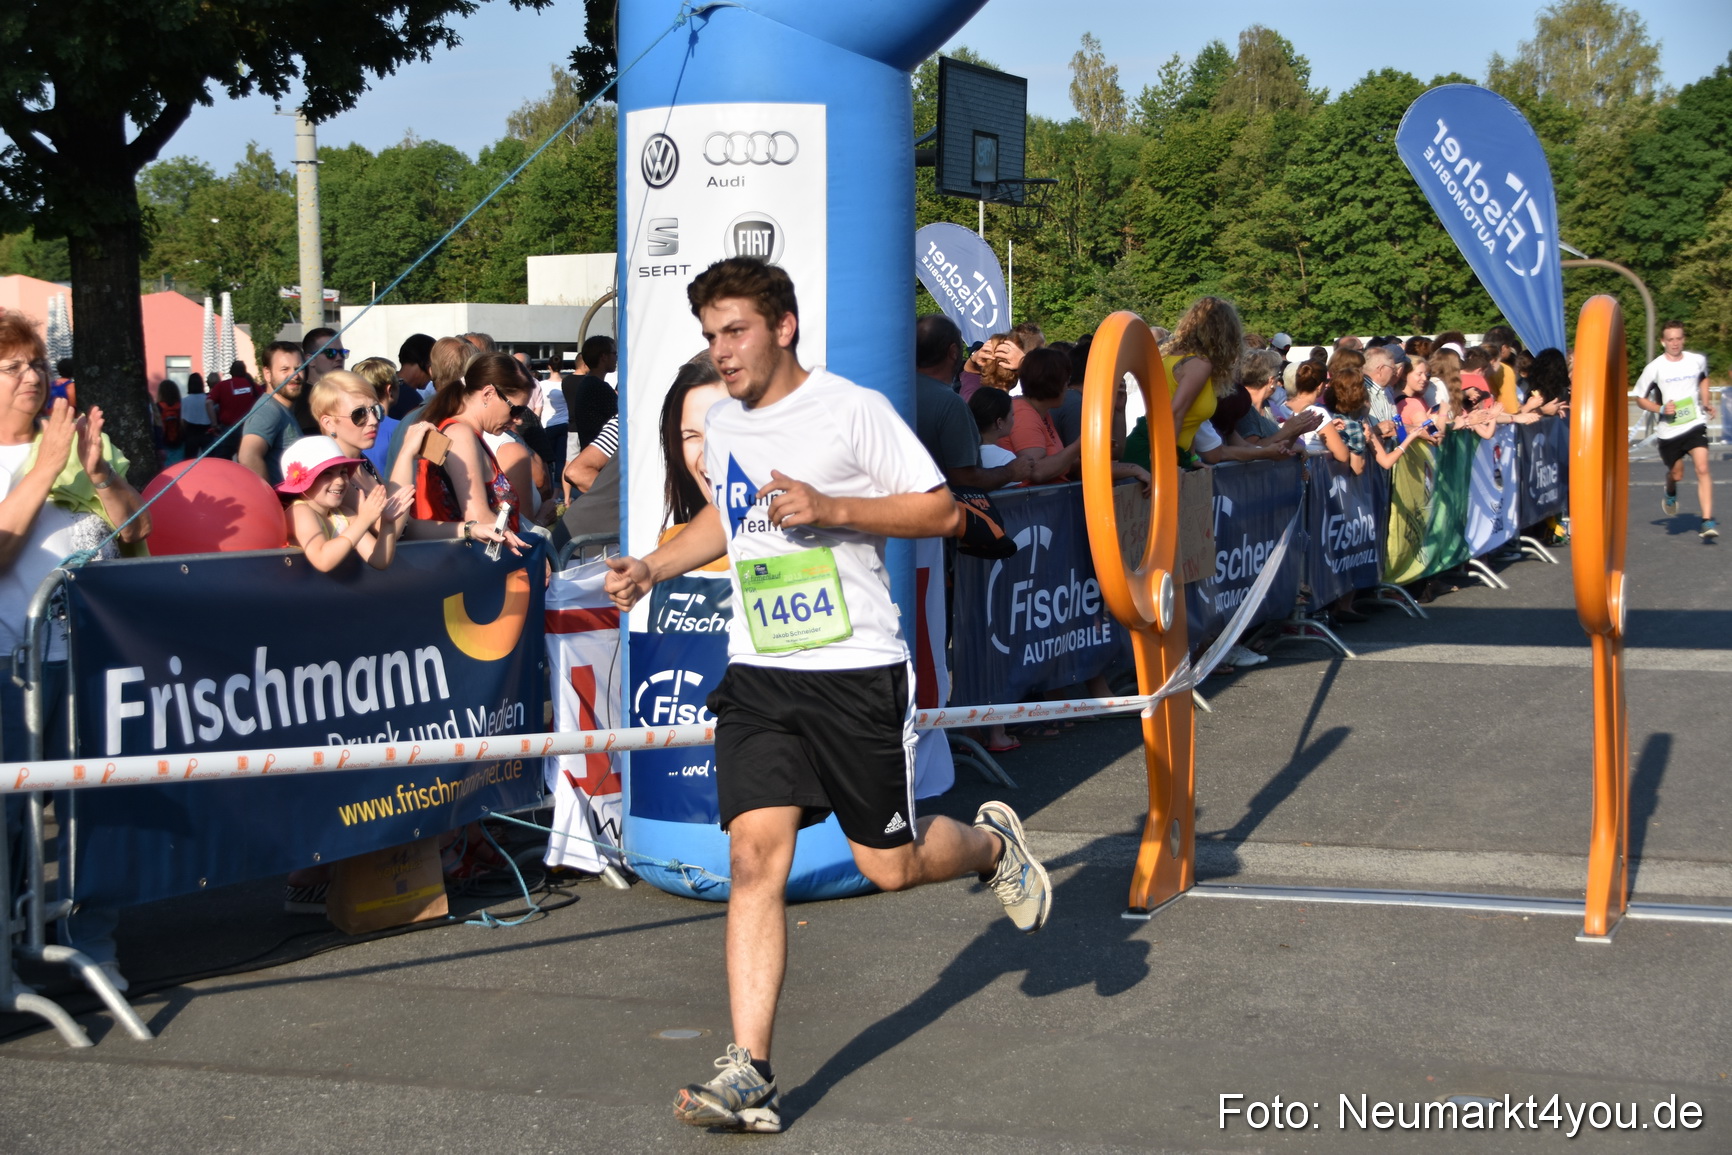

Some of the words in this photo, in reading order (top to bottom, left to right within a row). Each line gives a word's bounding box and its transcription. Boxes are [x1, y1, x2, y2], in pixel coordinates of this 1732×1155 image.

[706, 176, 746, 188] Audi
[738, 229, 772, 256] FIAT
[638, 264, 692, 278] SEAT
[1328, 506, 1376, 552] Fische
[1206, 533, 1274, 587] scher
[753, 587, 835, 627] 1464
[1010, 568, 1101, 635] Fische
[664, 609, 732, 632] Fisch
[772, 632, 789, 640] Jakob
[789, 626, 822, 637] Schneider
[1023, 623, 1111, 666] AUTOMOBILE
[106, 646, 450, 756] Frischmann
[653, 695, 718, 726] Fisc
[466, 698, 524, 738] Medien
[682, 759, 710, 777] und
[884, 820, 907, 834] adidas
